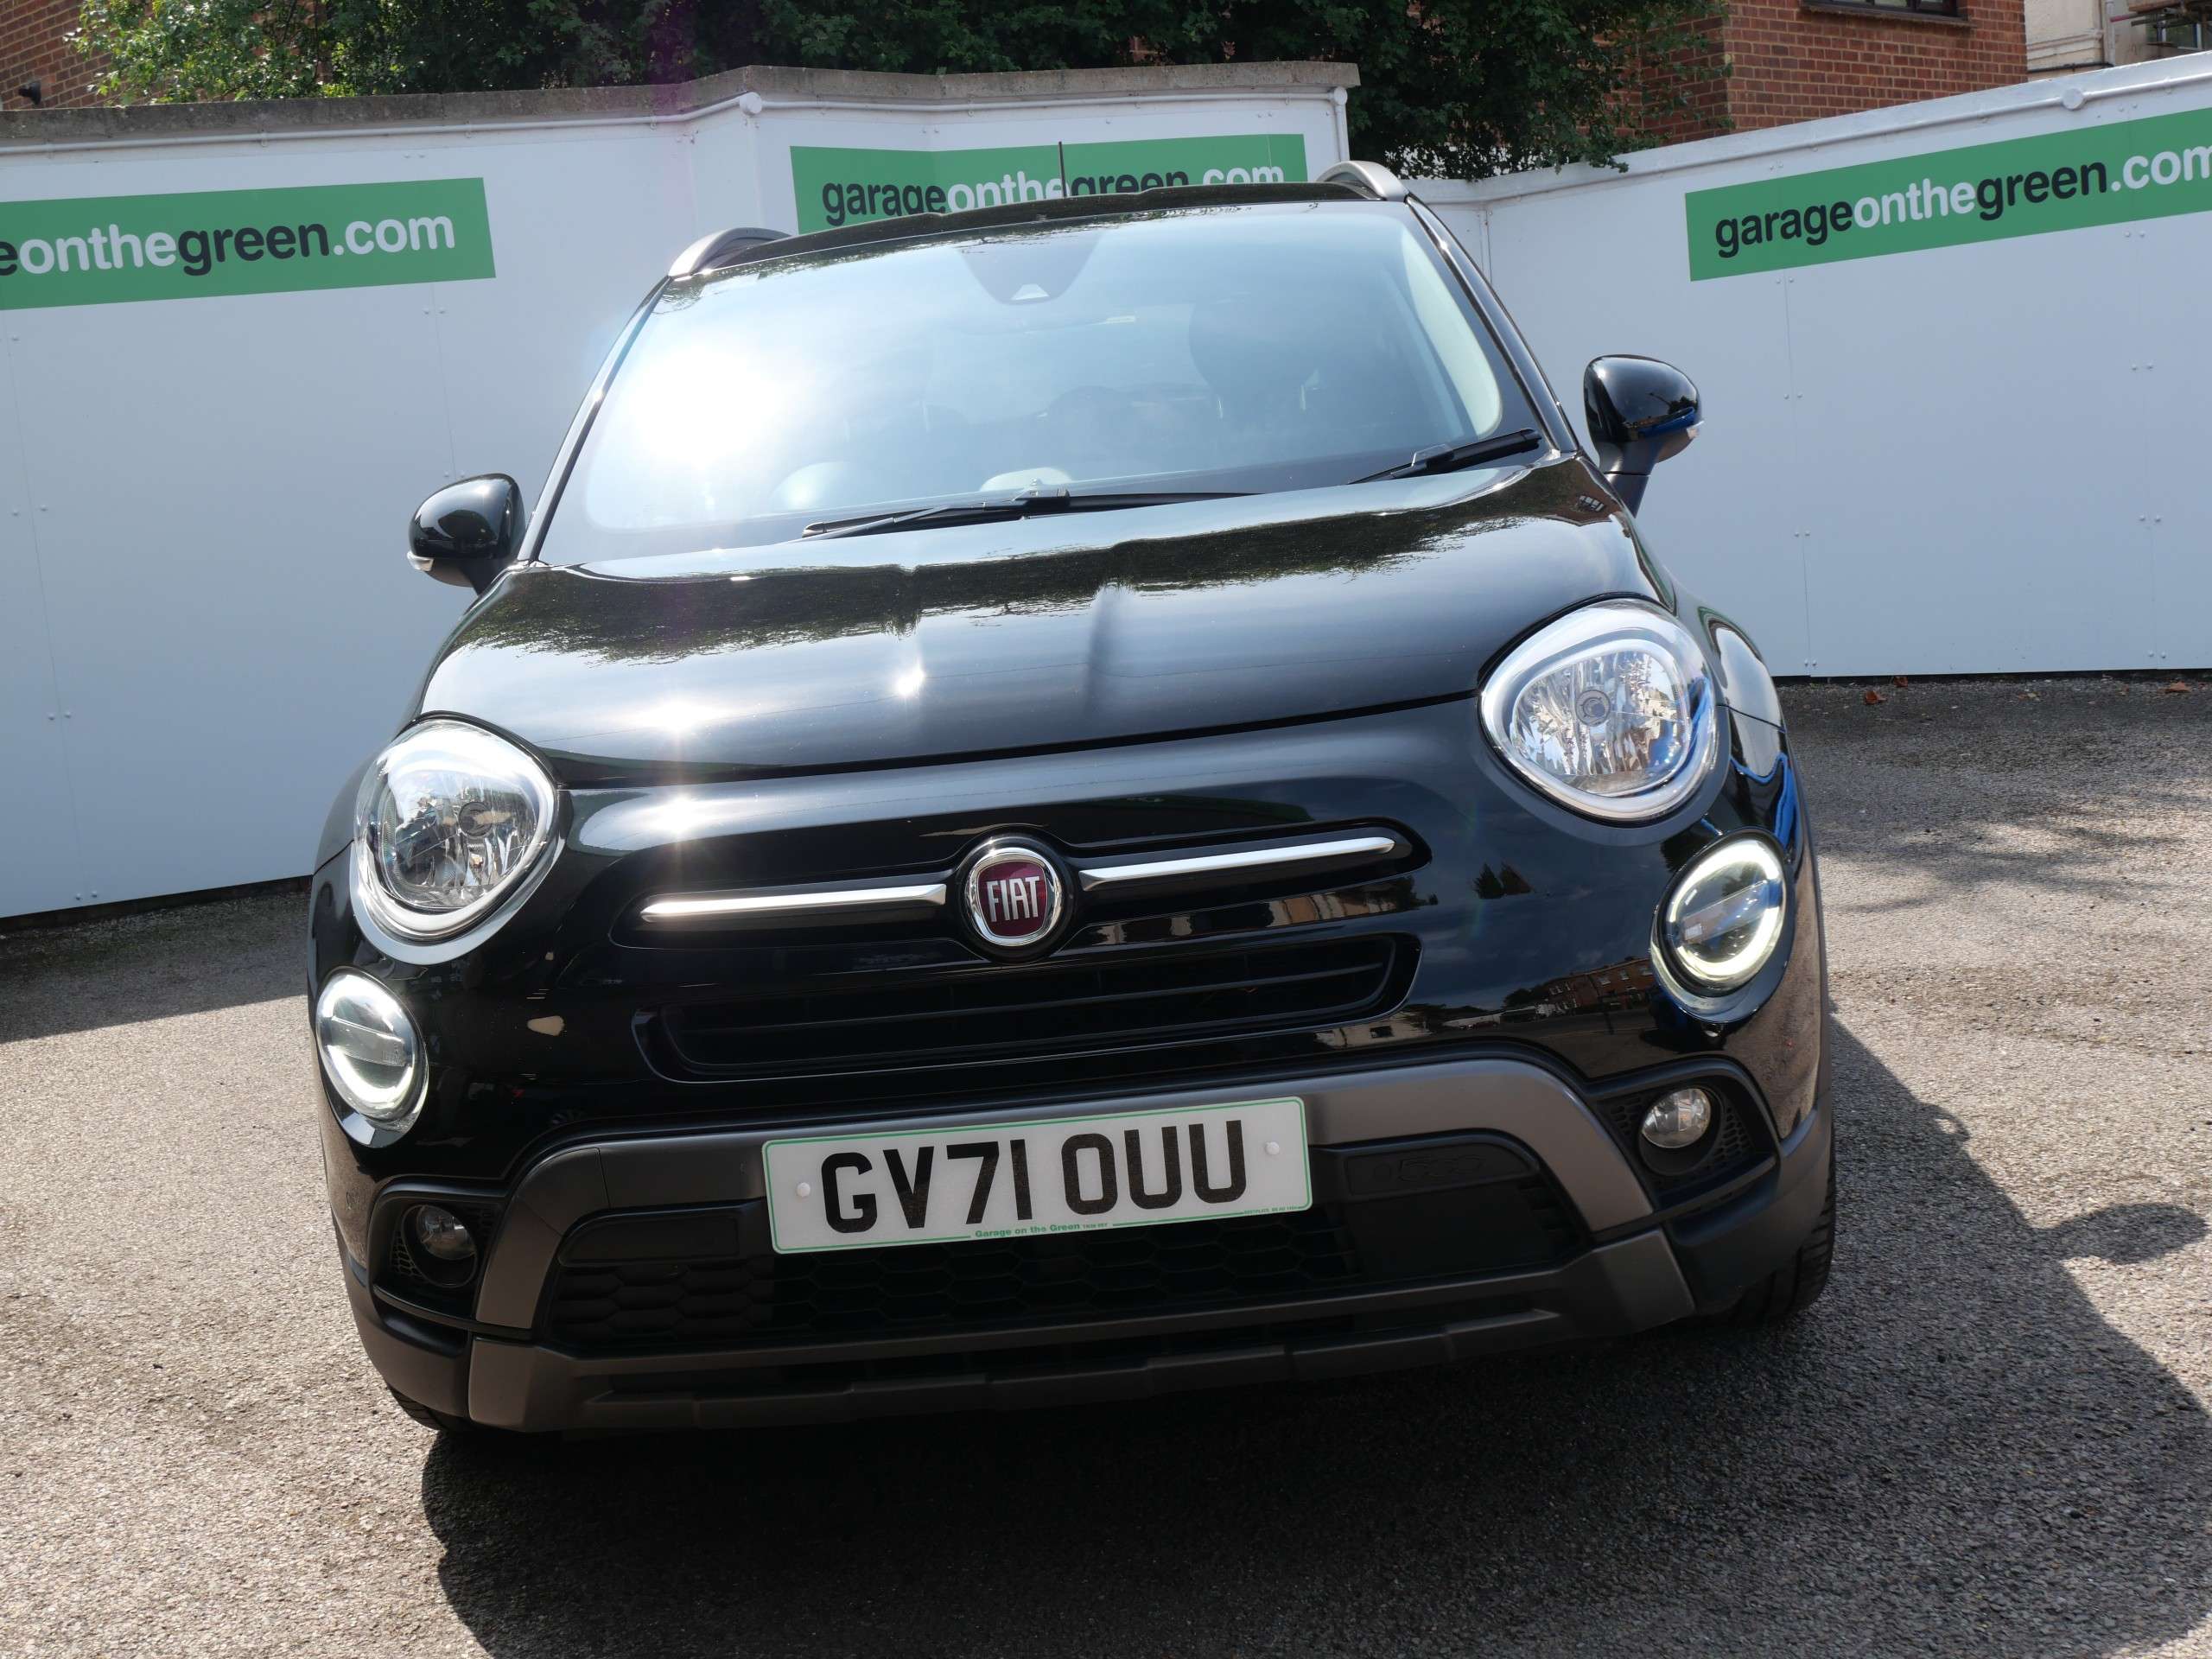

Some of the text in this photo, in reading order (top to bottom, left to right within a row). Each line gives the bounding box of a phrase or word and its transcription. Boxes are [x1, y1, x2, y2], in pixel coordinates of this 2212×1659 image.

[822, 166, 1286, 227] garageonthereencom
[1714, 144, 2212, 258] garageonthegreen.com
[986, 875, 1040, 923] FIAT
[821, 1120, 1248, 1234] GV71 OUU
[975, 1228, 1012, 1239] Garage
[1030, 1225, 1046, 1234] the
[1050, 1224, 1080, 1232] Green
